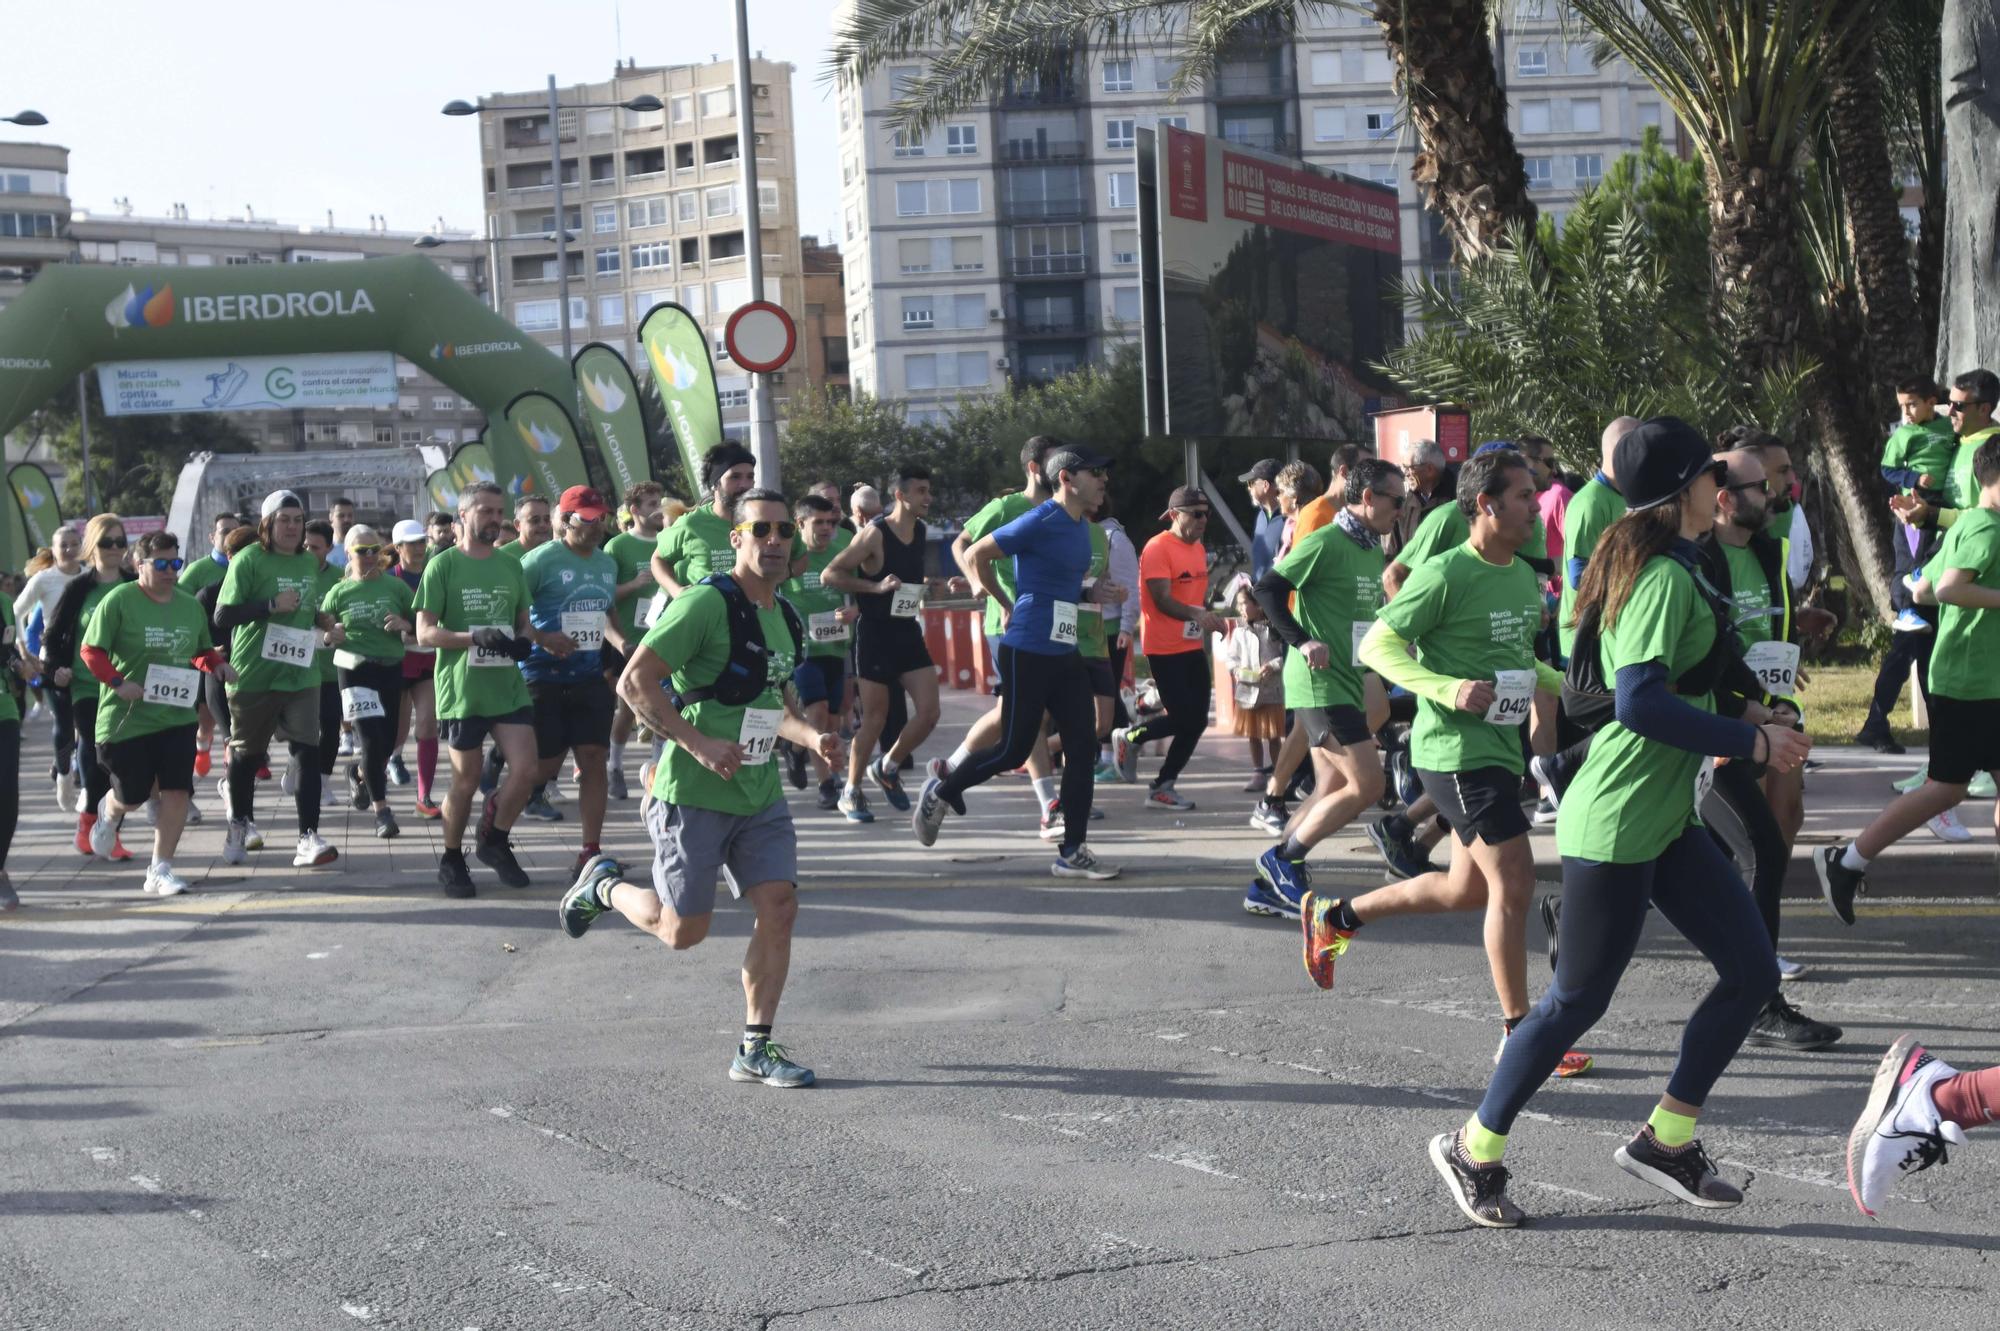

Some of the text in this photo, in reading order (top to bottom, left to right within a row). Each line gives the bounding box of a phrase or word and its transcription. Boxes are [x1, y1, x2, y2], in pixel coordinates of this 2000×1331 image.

[1227, 161, 1265, 191] MURCIA
[1297, 186, 1308, 201] DE
[1308, 187, 1362, 215] REVEGETACIÓN
[1361, 201, 1368, 215] Y
[1368, 203, 1396, 223] MEJORA
[1270, 199, 1282, 215] DE
[1283, 202, 1298, 219] LOS
[1299, 203, 1339, 229] MÁRGENES
[1340, 215, 1353, 232] DEL
[1353, 216, 1366, 236] RÍO
[183, 289, 375, 322] IBERDROLA
[454, 341, 522, 357] IBERDROLA
[117, 368, 158, 379] Murcia
[119, 378, 181, 390] en marcha
[302, 378, 330, 386] contra
[331, 377, 340, 385] el
[120, 389, 158, 399] contra
[120, 399, 132, 409] el
[1490, 609, 1512, 620] Murcia
[1501, 616, 1523, 627] marcha
[571, 630, 601, 643] 2312
[815, 625, 844, 637] 0964
[1491, 626, 1512, 636] contra
[271, 642, 306, 658] 1015
[151, 684, 190, 700] 1012
[348, 701, 378, 714] 2228
[1499, 696, 1530, 714] 0422
